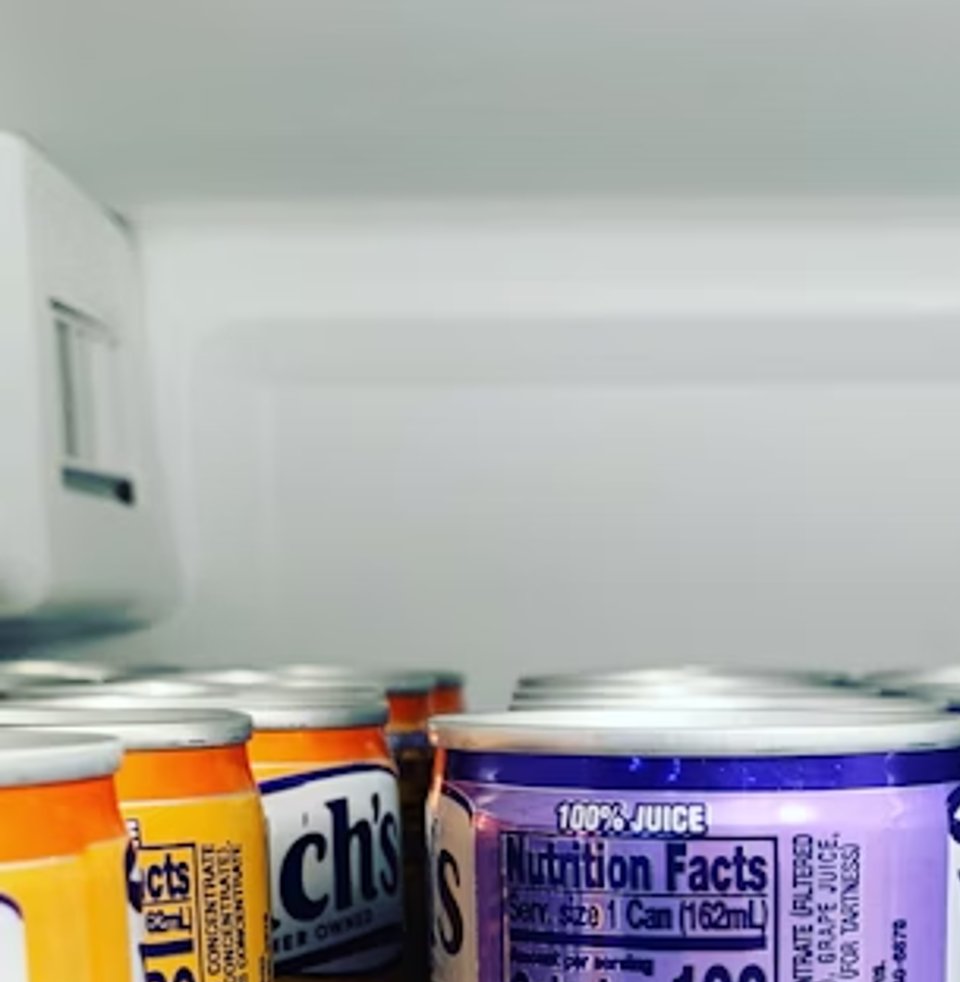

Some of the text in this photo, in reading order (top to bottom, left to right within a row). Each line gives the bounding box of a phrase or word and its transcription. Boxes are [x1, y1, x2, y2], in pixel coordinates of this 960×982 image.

[557, 803, 709, 837] 100% JUICE
[280, 792, 398, 922] ch's
[506, 836, 768, 892] Nutrition Facts
[202, 843, 220, 976] CONCENTRATE
[626, 901, 673, 930] Can
[678, 900, 768, 936] (162mL)
[817, 902, 838, 964] GRAPE
